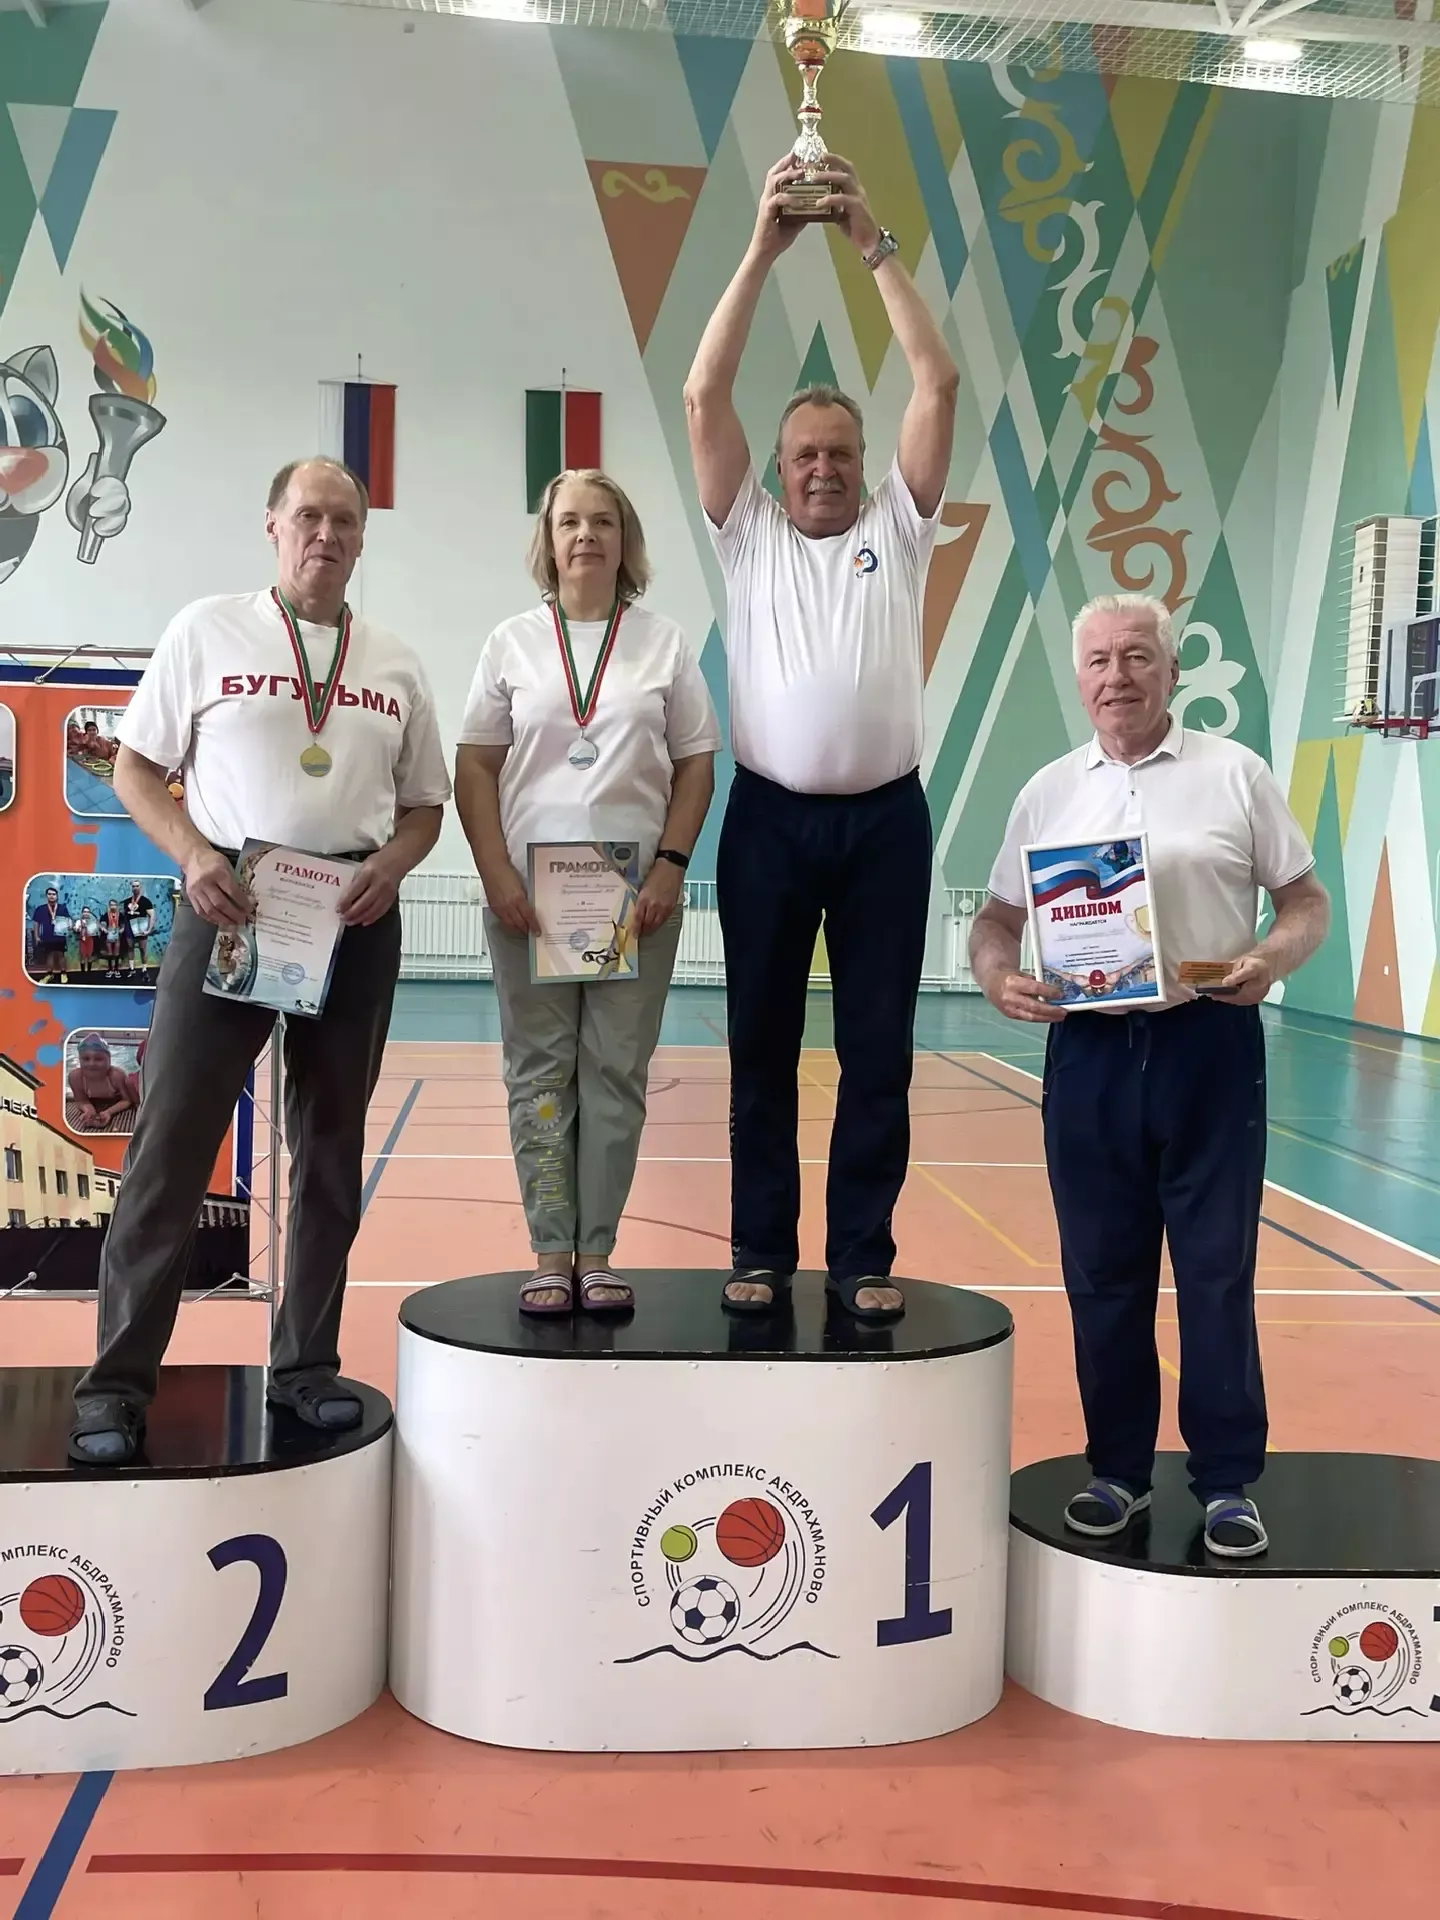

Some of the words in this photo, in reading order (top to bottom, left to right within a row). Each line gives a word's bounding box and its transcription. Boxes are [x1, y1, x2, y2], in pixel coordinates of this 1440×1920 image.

[274, 862, 341, 887] ГРАМОТА
[549, 861, 617, 873] ГРАМОТА
[1051, 900, 1123, 923] ДИПЛОМ
[630, 1488, 674, 1607] СПОРТИВНЫЙ
[673, 1463, 767, 1493] КОМПЛЕКС
[768, 1476, 826, 1604] АБДРАХМАНОВО
[870, 1461, 952, 1647] 1
[70, 1554, 125, 1668] АБДРАХМАНОВО
[204, 1533, 288, 1711] 2
[1336, 1601, 1389, 1619] КОМПЛЕКС
[1389, 1609, 1423, 1685] АБДРАХМАНОВО
